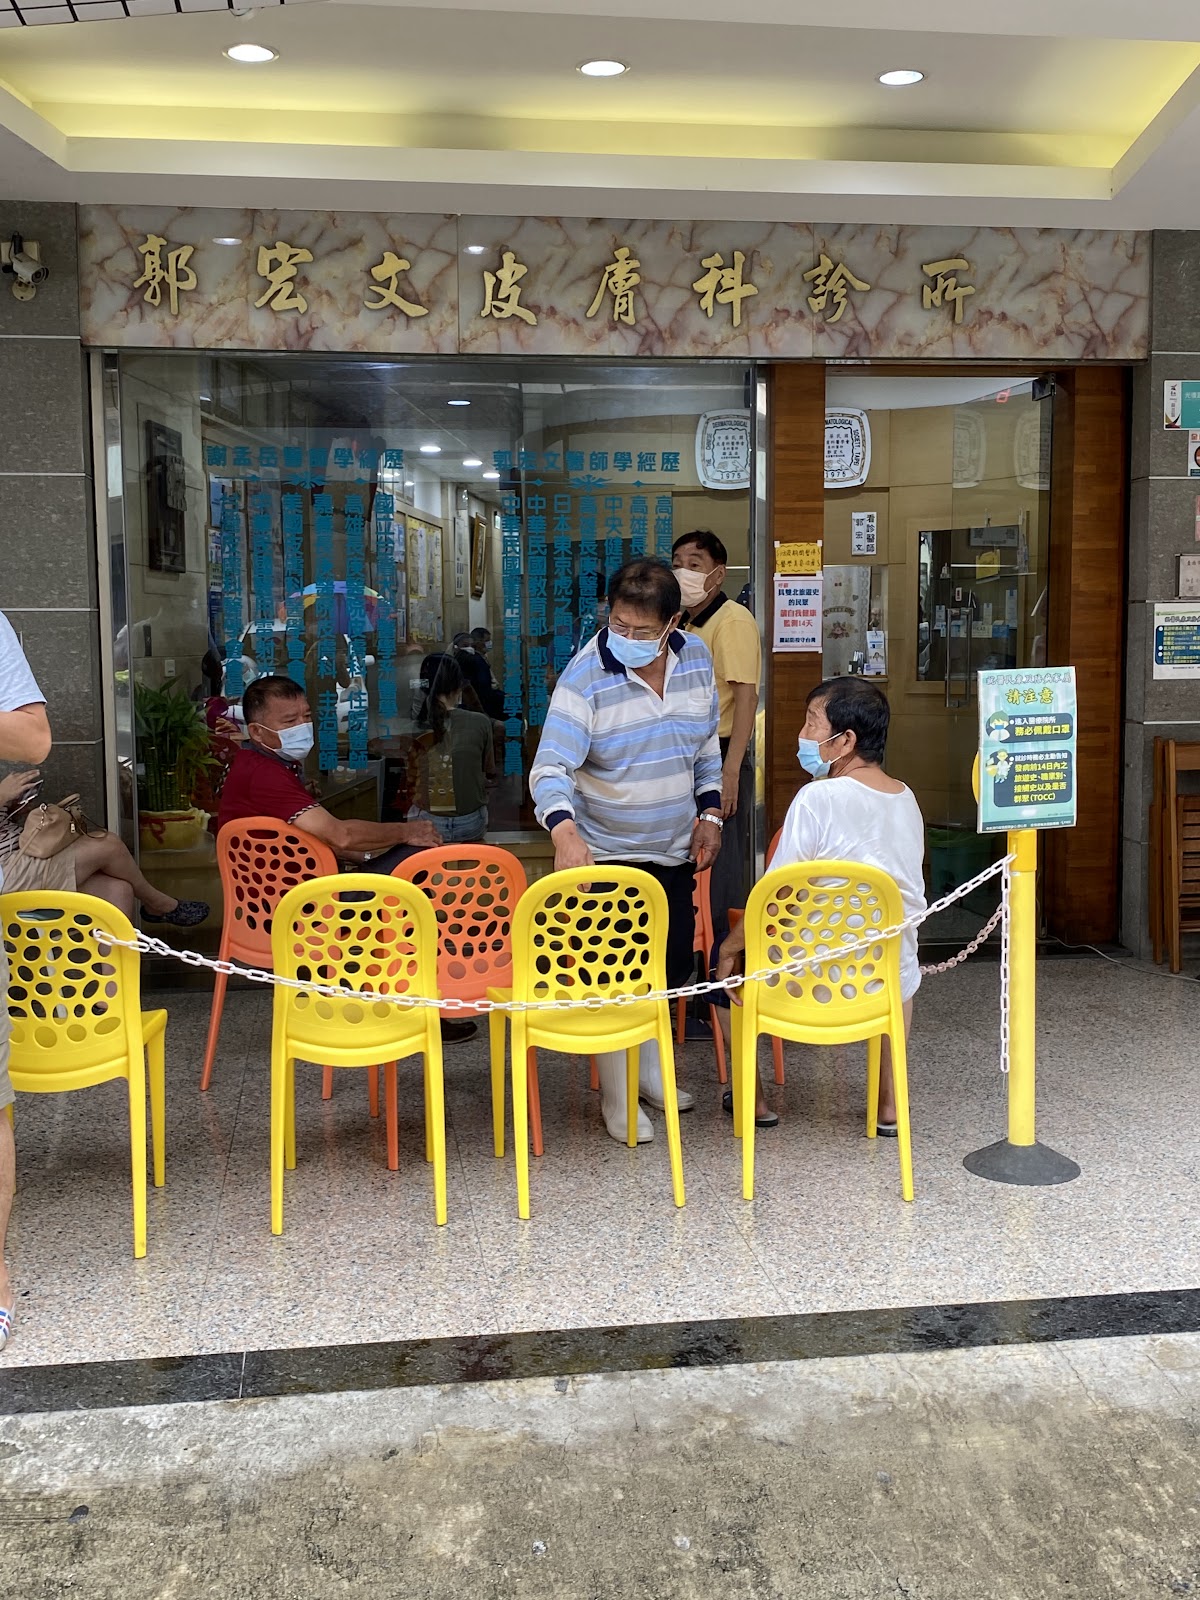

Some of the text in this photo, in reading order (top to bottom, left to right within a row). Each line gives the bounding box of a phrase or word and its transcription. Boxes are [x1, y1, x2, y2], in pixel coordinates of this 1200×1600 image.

[133, 234, 977, 327] 郭宏文皮膚科診所
[825, 418, 852, 426] MATOLOGICAL
[492, 449, 680, 472] 郭宏文醫師學經歷
[629, 495, 648, 558] 高雄長
[1005, 686, 1054, 705] 請注意
